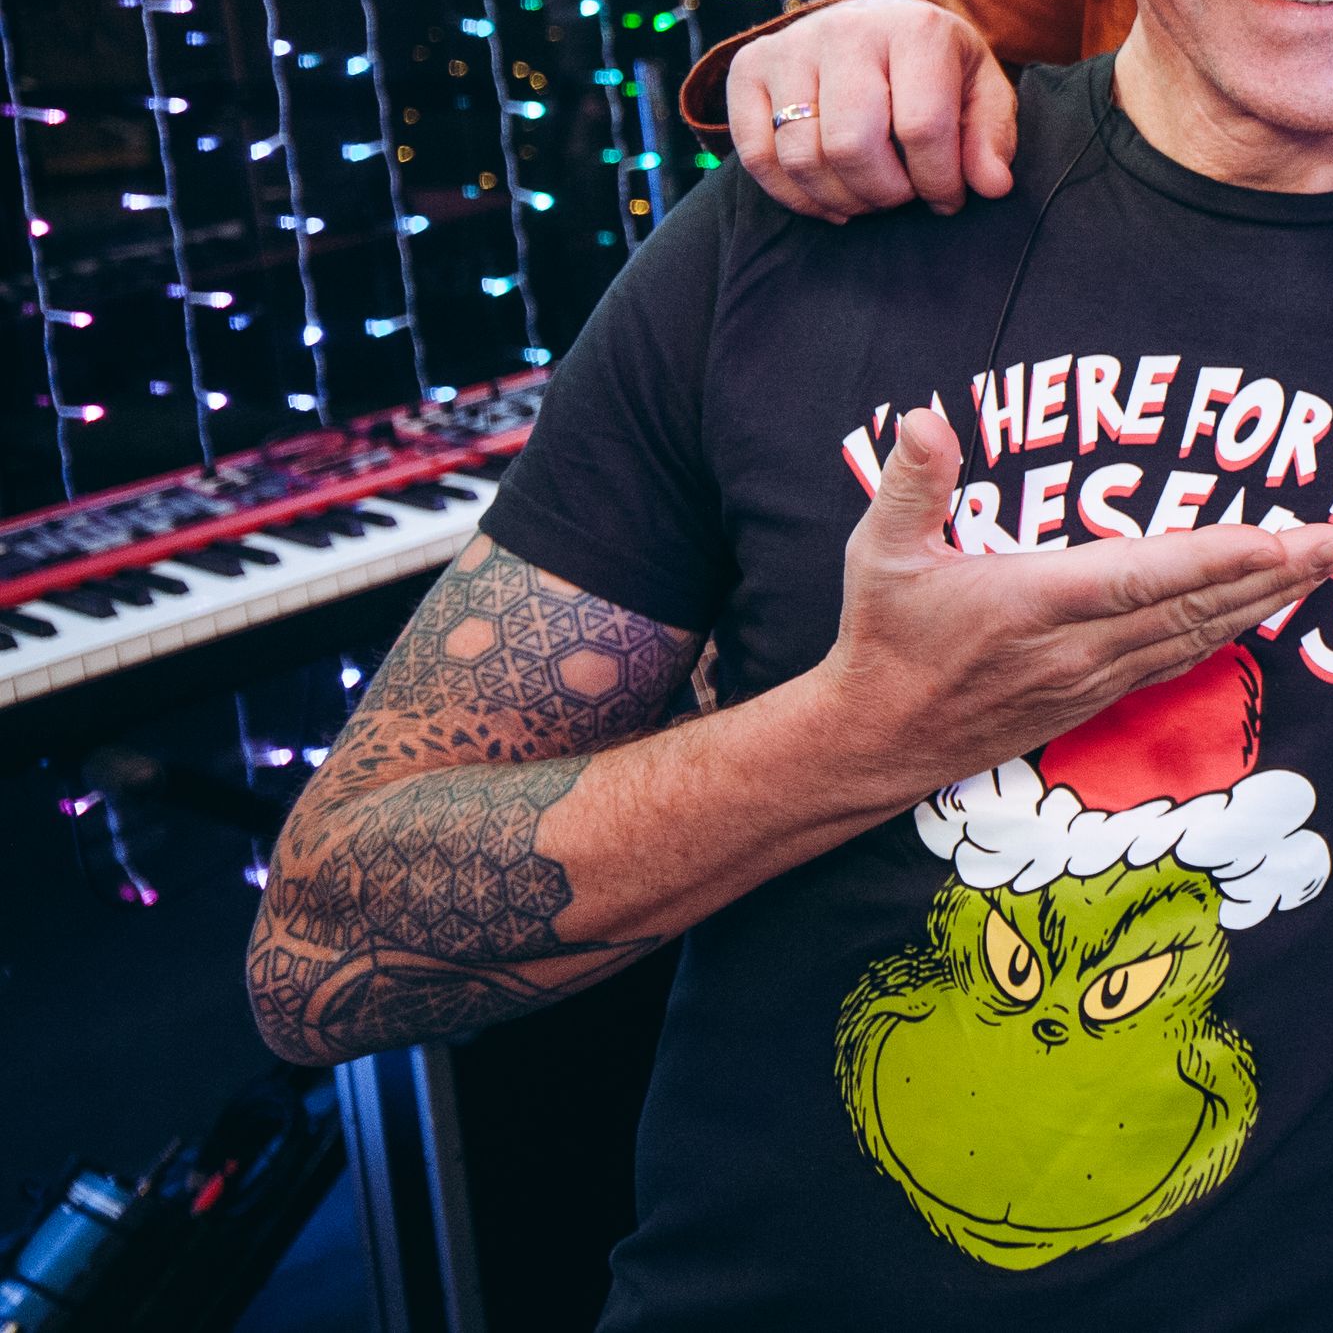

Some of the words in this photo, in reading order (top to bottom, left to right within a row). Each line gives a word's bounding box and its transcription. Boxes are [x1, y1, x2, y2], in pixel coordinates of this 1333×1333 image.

[841, 389, 964, 503] I'
[970, 354, 1181, 468] HERE
[1180, 366, 1333, 488] FOR
